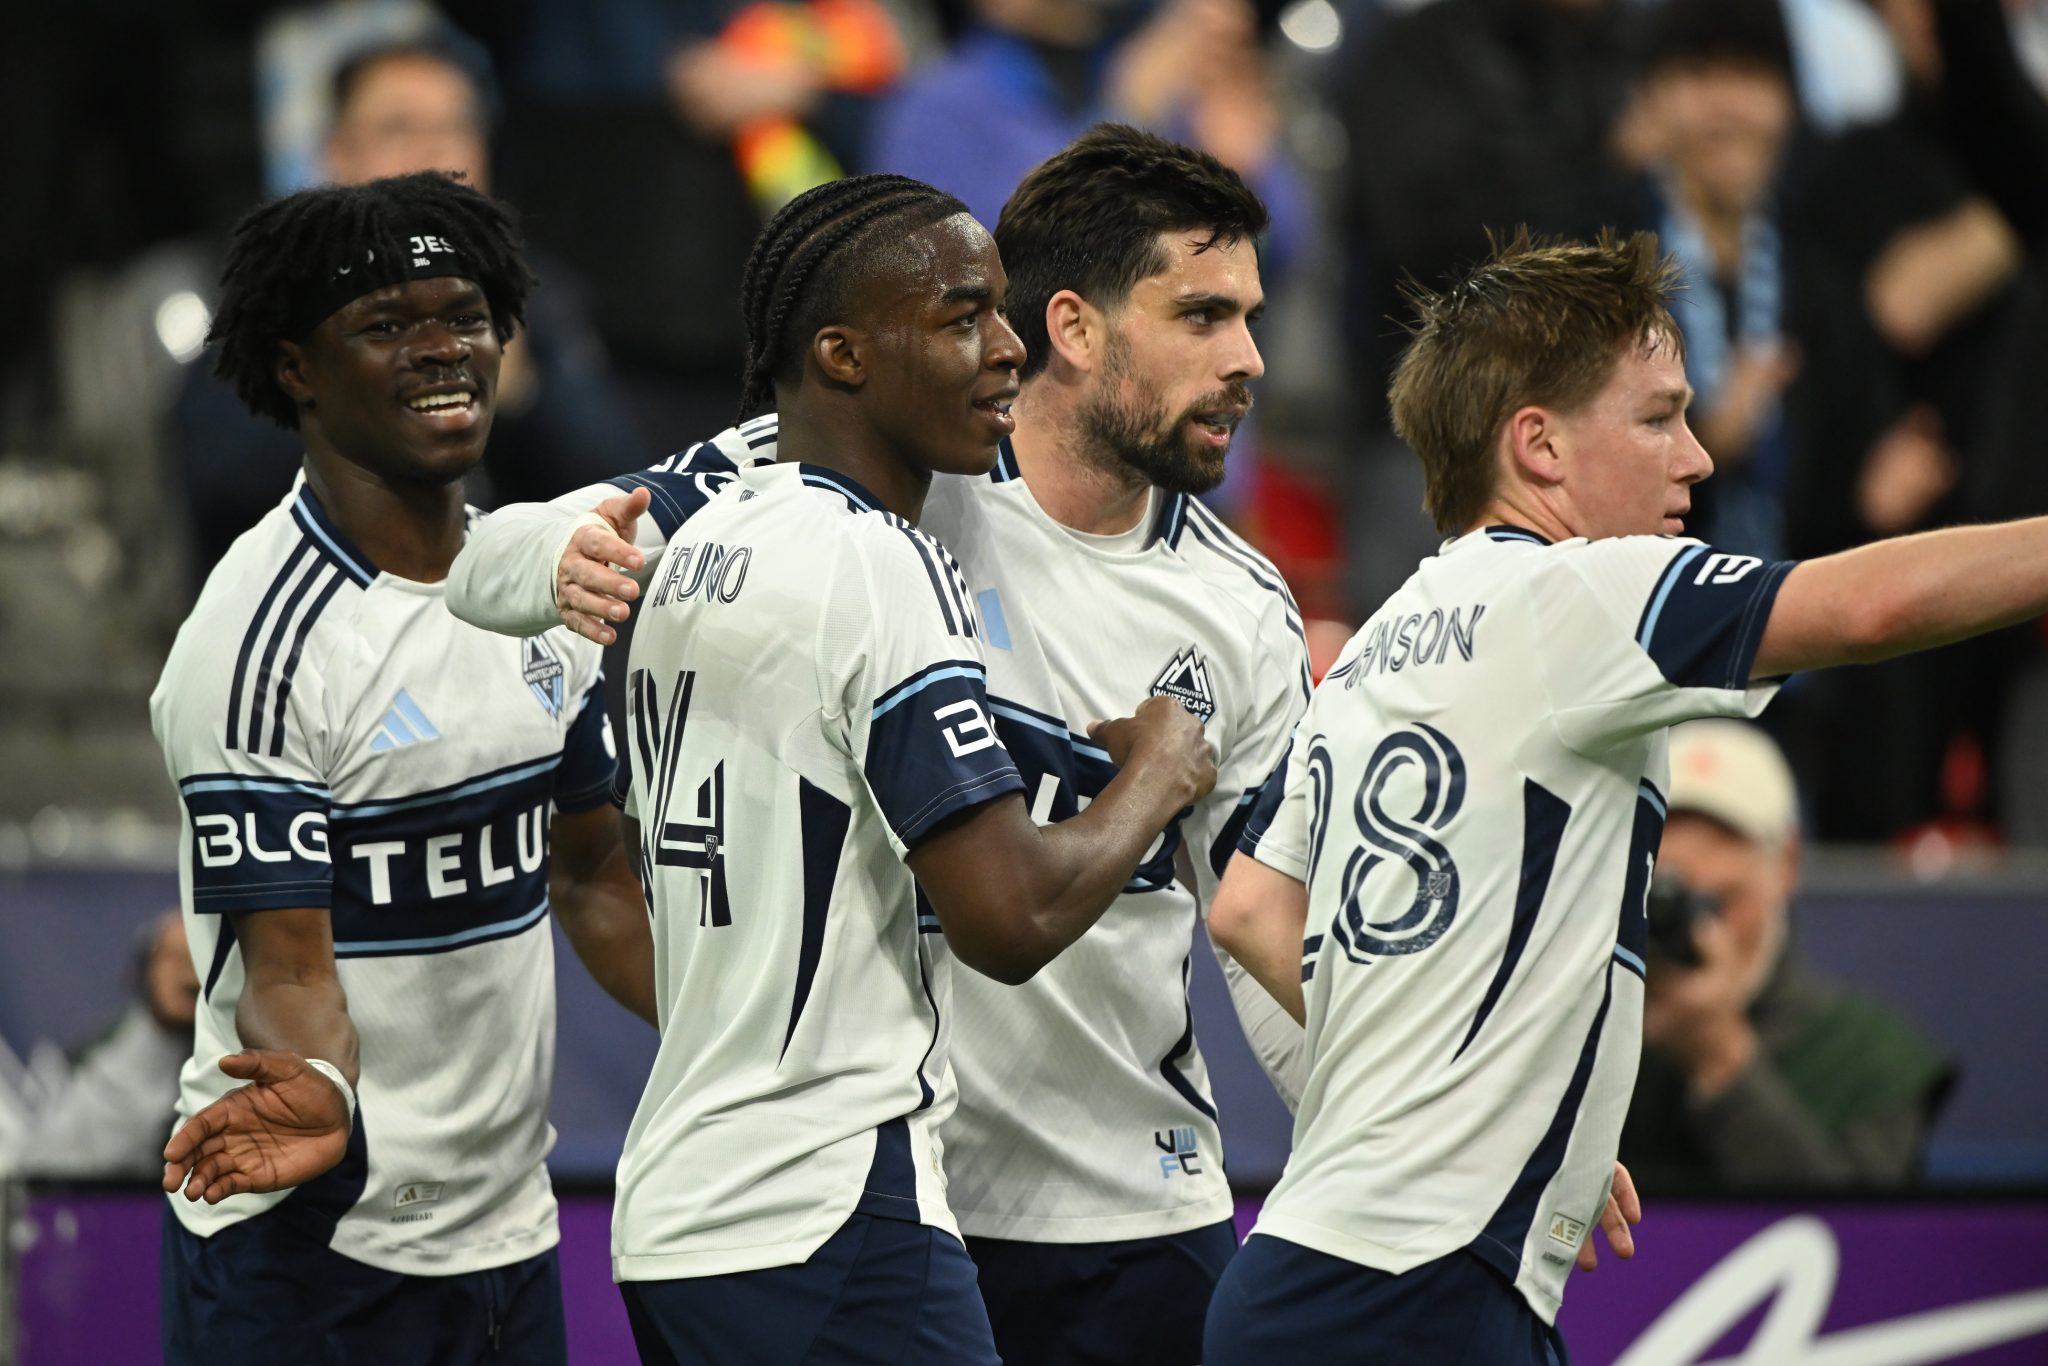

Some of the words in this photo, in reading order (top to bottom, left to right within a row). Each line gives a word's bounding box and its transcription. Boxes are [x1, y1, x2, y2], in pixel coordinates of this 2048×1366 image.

[1166, 683, 1203, 700] VANCOUVER
[195, 811, 332, 867] BLG
[352, 804, 549, 905] TELU
